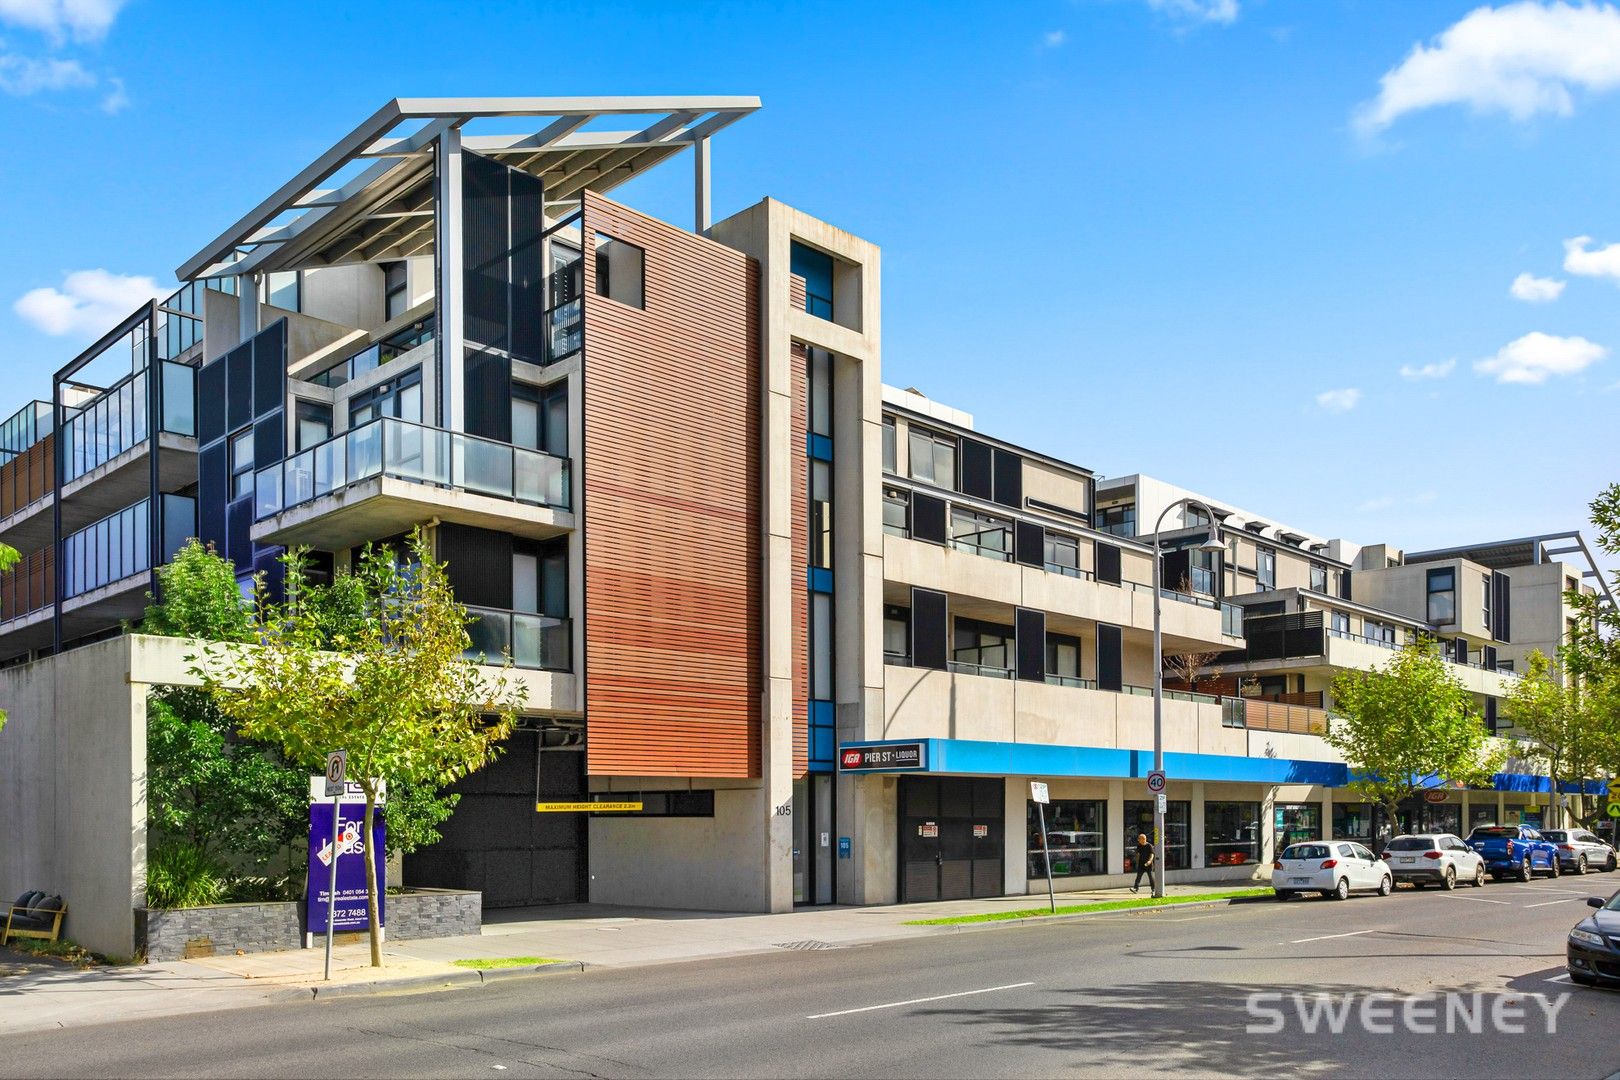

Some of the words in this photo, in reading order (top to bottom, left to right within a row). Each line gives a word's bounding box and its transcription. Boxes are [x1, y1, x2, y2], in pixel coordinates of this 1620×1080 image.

[844, 753, 861, 763] IGA
[864, 752, 880, 762] PIER
[882, 751, 892, 761] ST
[895, 750, 918, 759] LIQUOR
[1150, 778, 1163, 787] 40
[776, 805, 791, 815] 105
[348, 908, 366, 916] 7488
